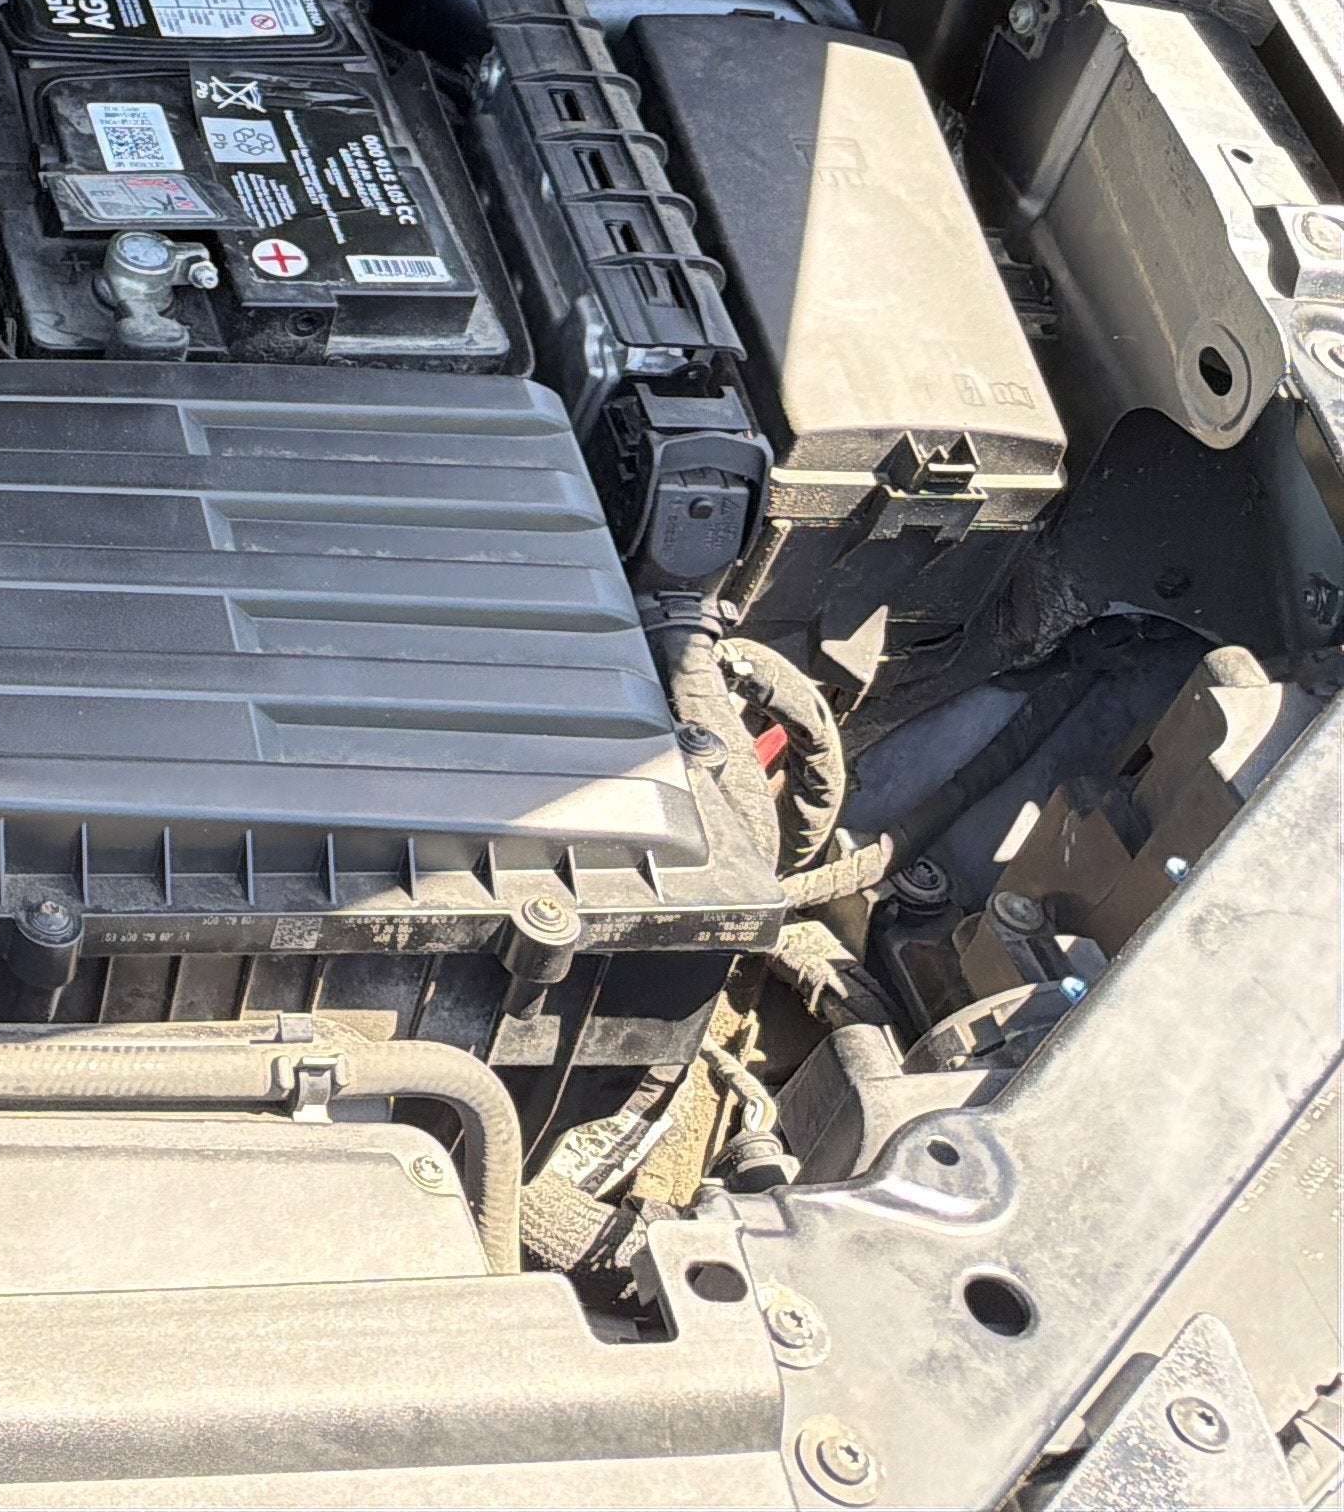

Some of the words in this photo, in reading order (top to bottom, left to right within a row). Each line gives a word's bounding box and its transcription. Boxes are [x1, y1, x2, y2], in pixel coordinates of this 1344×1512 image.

[194, 80, 209, 99] Pb
[211, 133, 228, 150] Pb
[362, 134, 387, 158] 000
[372, 159, 399, 182] 915
[395, 205, 418, 225] CC
